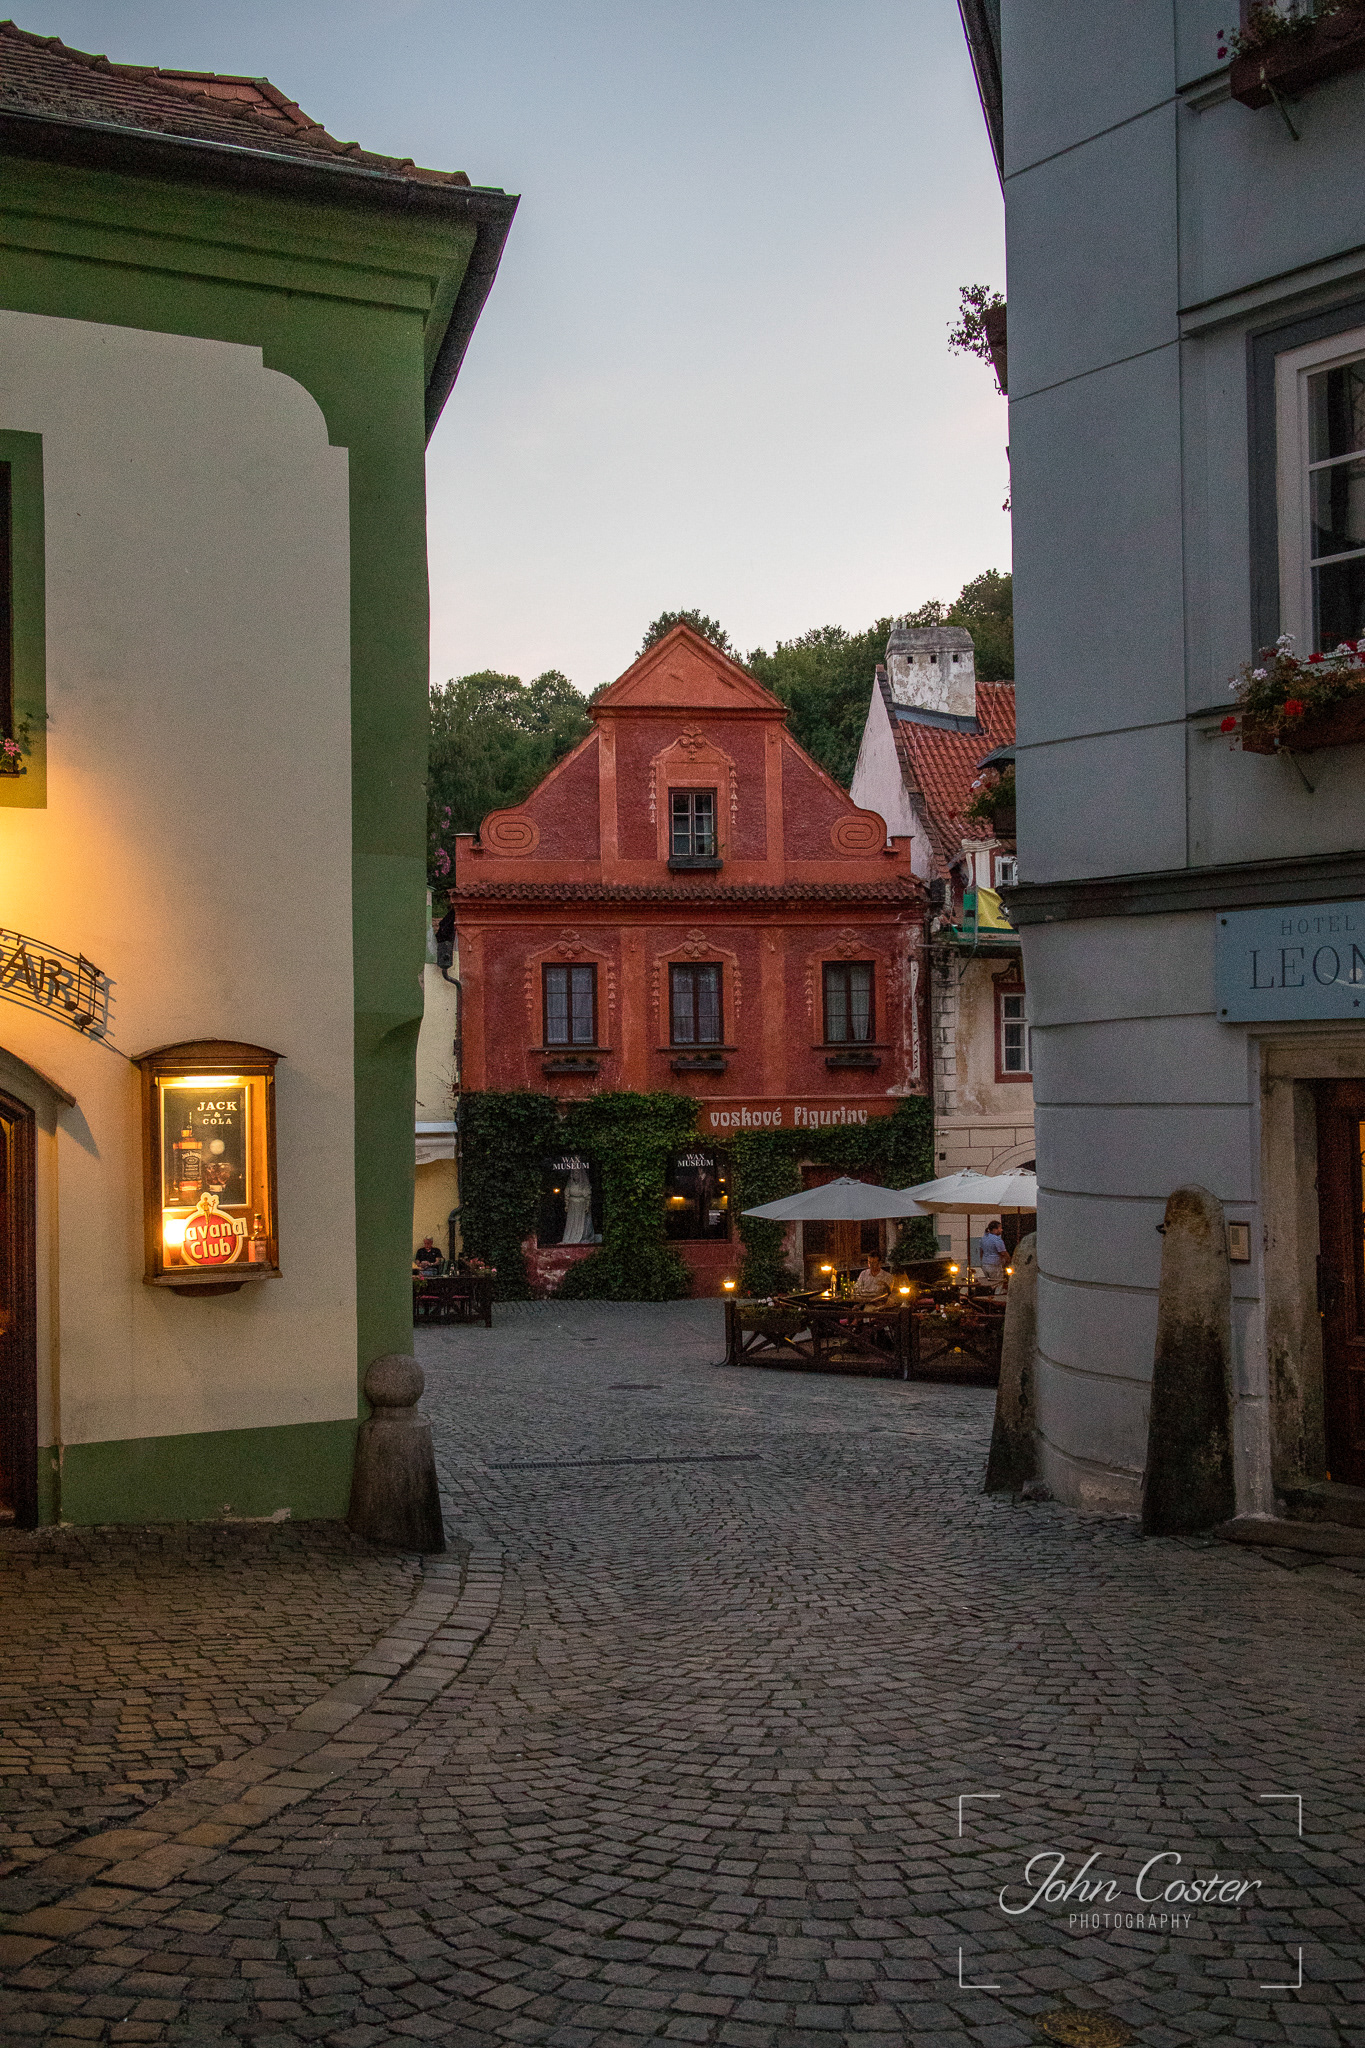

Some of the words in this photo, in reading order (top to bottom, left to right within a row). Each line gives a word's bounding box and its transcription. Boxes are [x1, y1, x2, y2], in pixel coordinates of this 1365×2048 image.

[1281, 915, 1355, 935] HOTEL
[197, 1101, 238, 1112] JACK
[710, 1107, 782, 1127] voskové
[553, 1162, 590, 1170] MUSEUM
[677, 1159, 714, 1167] MUSEUM
[184, 1220, 243, 1241] avana
[190, 1238, 231, 1258] Club
